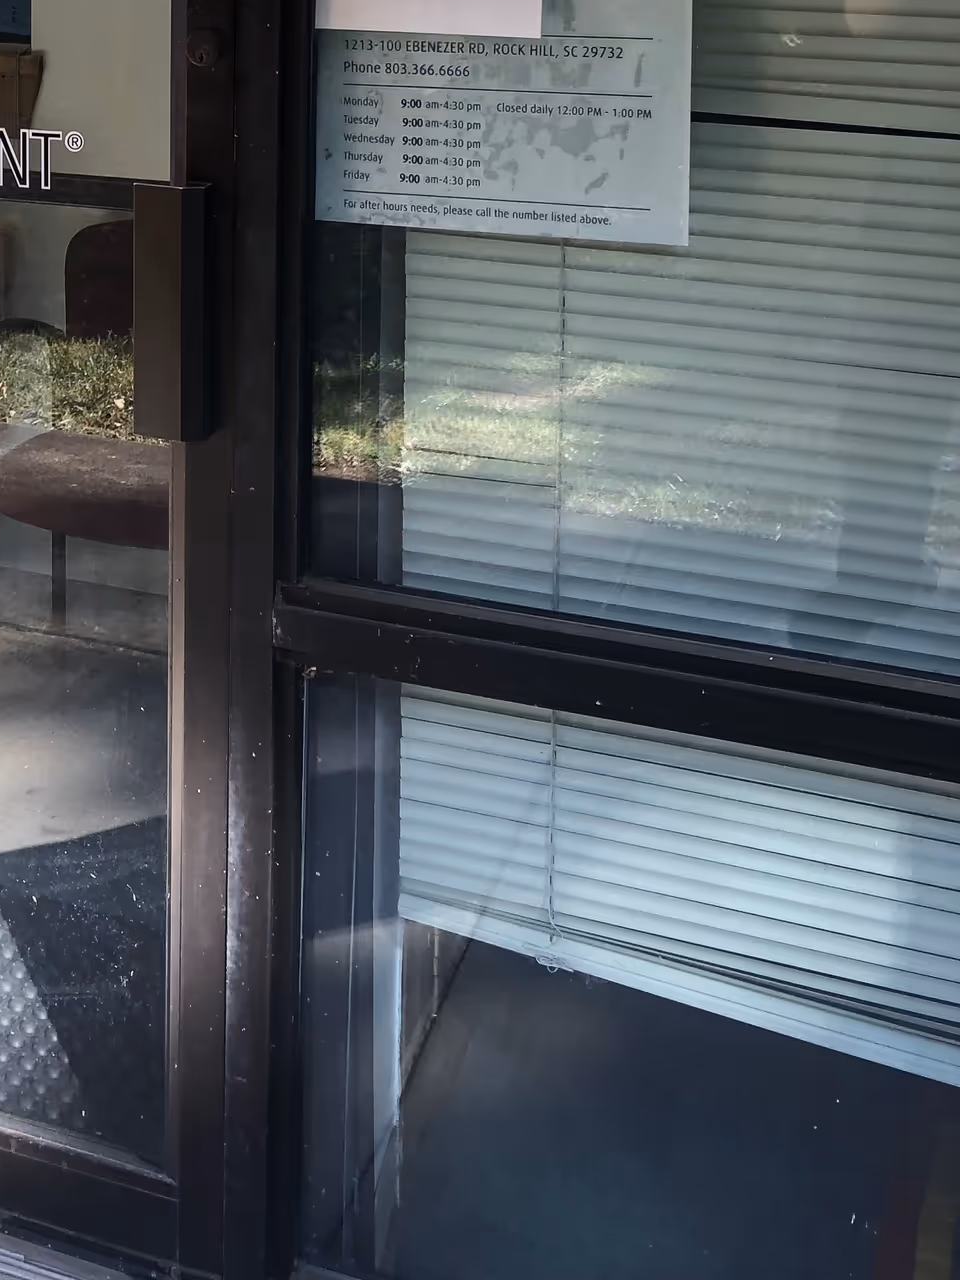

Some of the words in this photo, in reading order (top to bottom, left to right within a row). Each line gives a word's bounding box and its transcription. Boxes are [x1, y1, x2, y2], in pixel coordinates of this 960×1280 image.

[344, 39, 402, 52] 1213-100
[406, 40, 465, 54] EBENEZER
[469, 42, 489, 57] RD,
[493, 42, 526, 56] ROCK
[530, 44, 559, 58] HILL,
[563, 45, 578, 58] SC
[582, 46, 624, 59] 29732
[343, 61, 381, 74] Phone
[385, 63, 470, 77] 803.366.6666
[343, 97, 379, 109] Monday
[401, 99, 422, 109] 9:00
[425, 101, 464, 111] am-4:30
[466, 103, 482, 113] pm
[496, 102, 528, 114] Closed
[530, 104, 553, 117] daily
[557, 106, 584, 116] 12:00
[587, 107, 602, 117] PM
[613, 108, 634, 118] 1:00
[637, 109, 652, 119] PM
[343, 115, 379, 127] Tuesday
[402, 118, 423, 128] 9:00
[425, 119, 464, 129] am-4:30
[466, 122, 481, 131] pm
[343, 133, 395, 147] Wednesday
[402, 136, 423, 147] 9:00
[425, 138, 464, 148] am-4:30
[466, 140, 481, 150] pm
[344, 151, 383, 164] Thursday
[402, 154, 423, 165] 9:00
[425, 156, 464, 166] am-4:30
[466, 158, 481, 168] pm
[343, 170, 370, 182] Friday
[400, 173, 420, 183] 9:00
[425, 175, 464, 185] am-4:30
[466, 178, 481, 188] pm
[343, 199, 356, 209] For
[359, 200, 380, 210] after
[383, 201, 408, 212] hours
[411, 204, 440, 215] needs,
[443, 205, 473, 216] please
[475, 207, 491, 217] call
[494, 209, 509, 219] the
[512, 210, 548, 221] number
[551, 211, 577, 223] listed
[579, 213, 612, 226] above.
